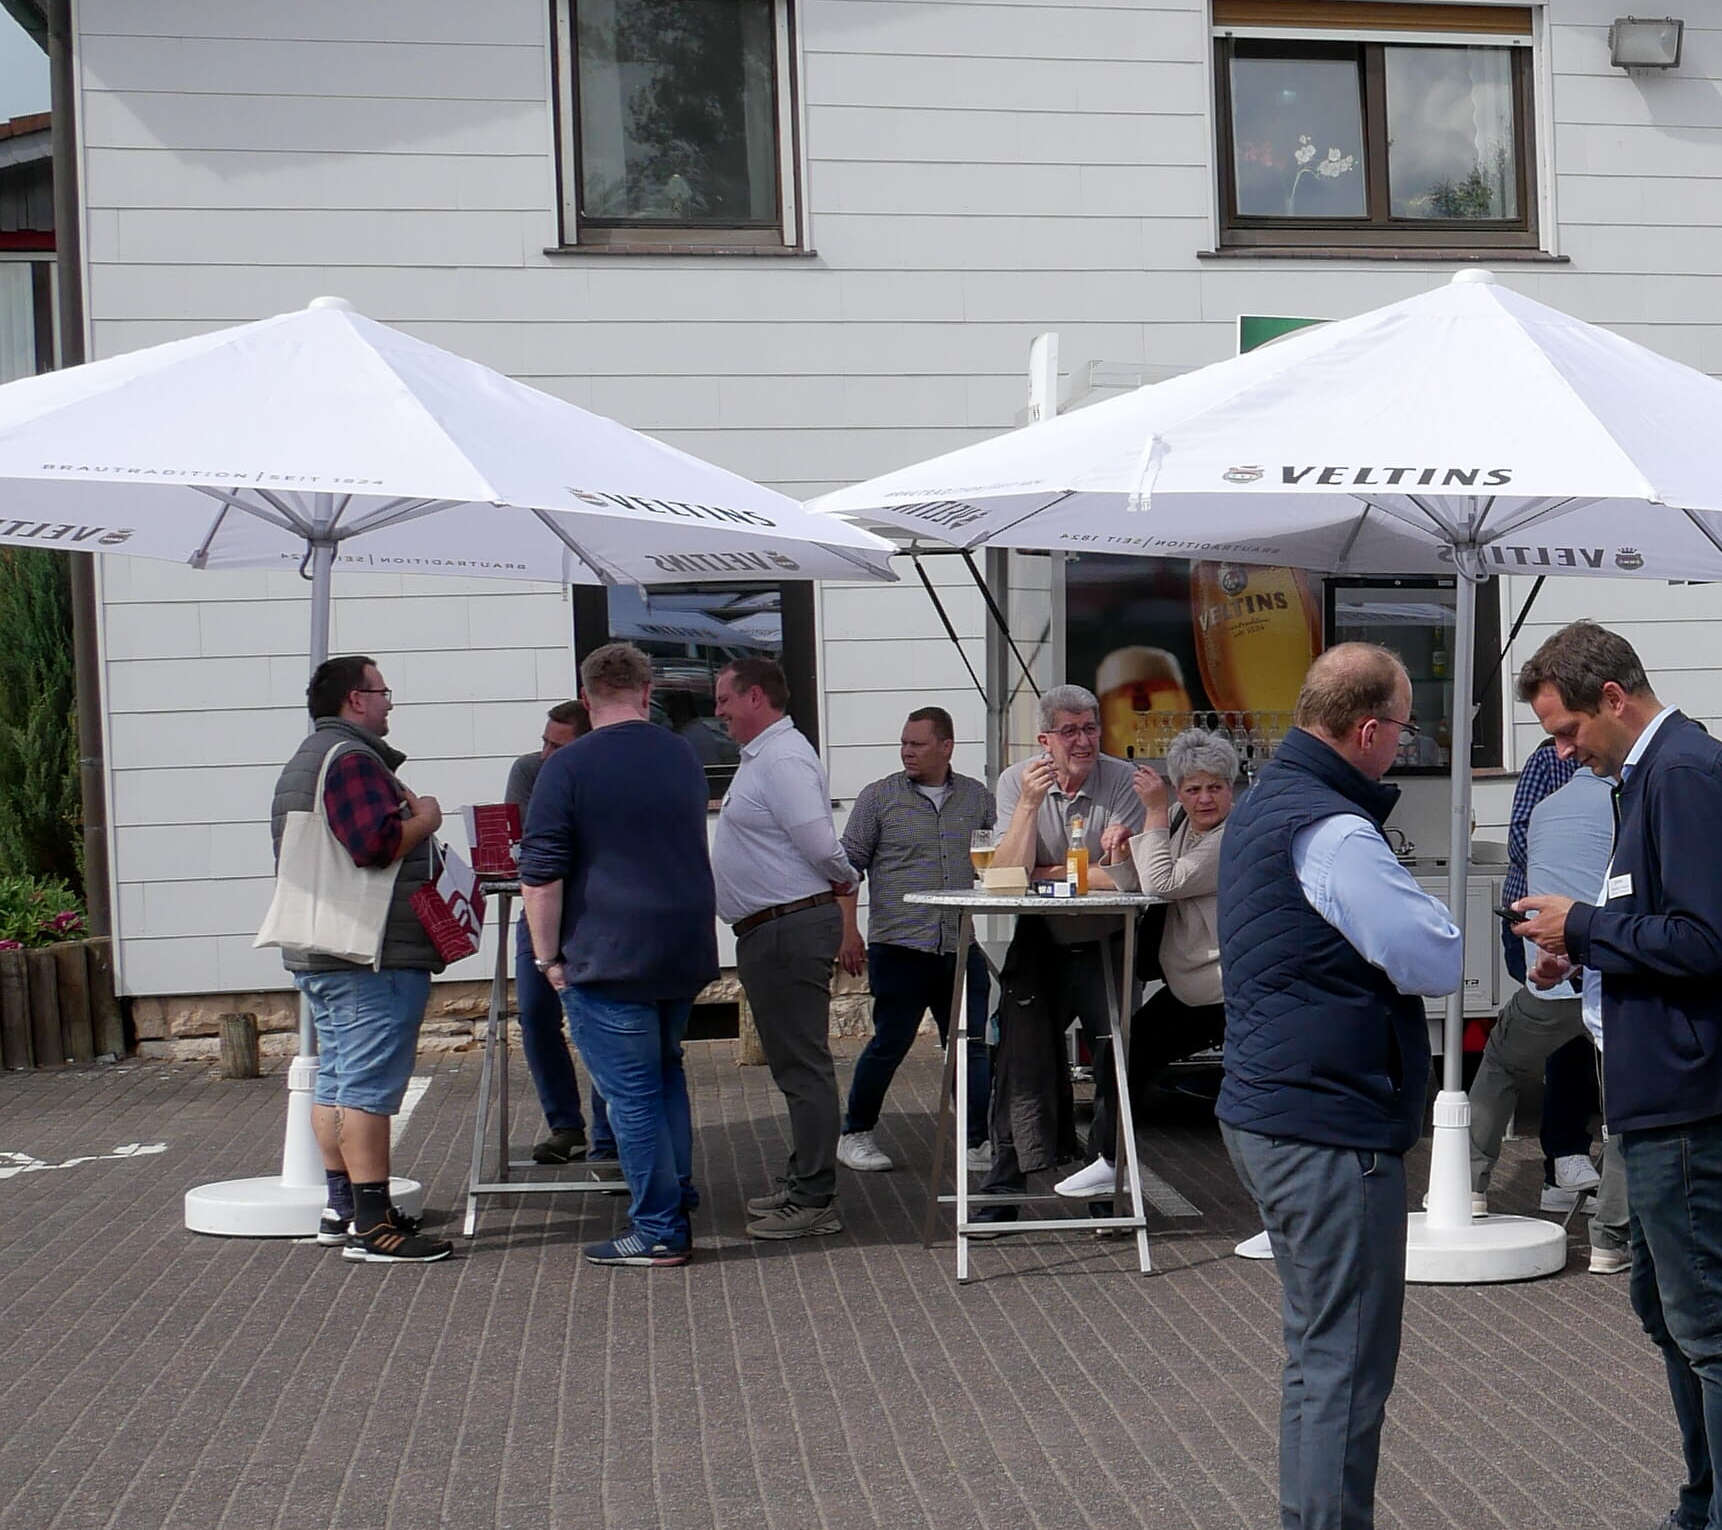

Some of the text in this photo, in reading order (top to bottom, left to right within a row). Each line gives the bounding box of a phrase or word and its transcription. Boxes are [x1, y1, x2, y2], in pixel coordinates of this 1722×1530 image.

[42, 463, 249, 479] BRAUTRADITION
[269, 474, 321, 483] SEIT
[1281, 465, 1514, 486] VELTINS
[597, 491, 777, 528] VELTINS
[1199, 590, 1289, 632] VELTINS
